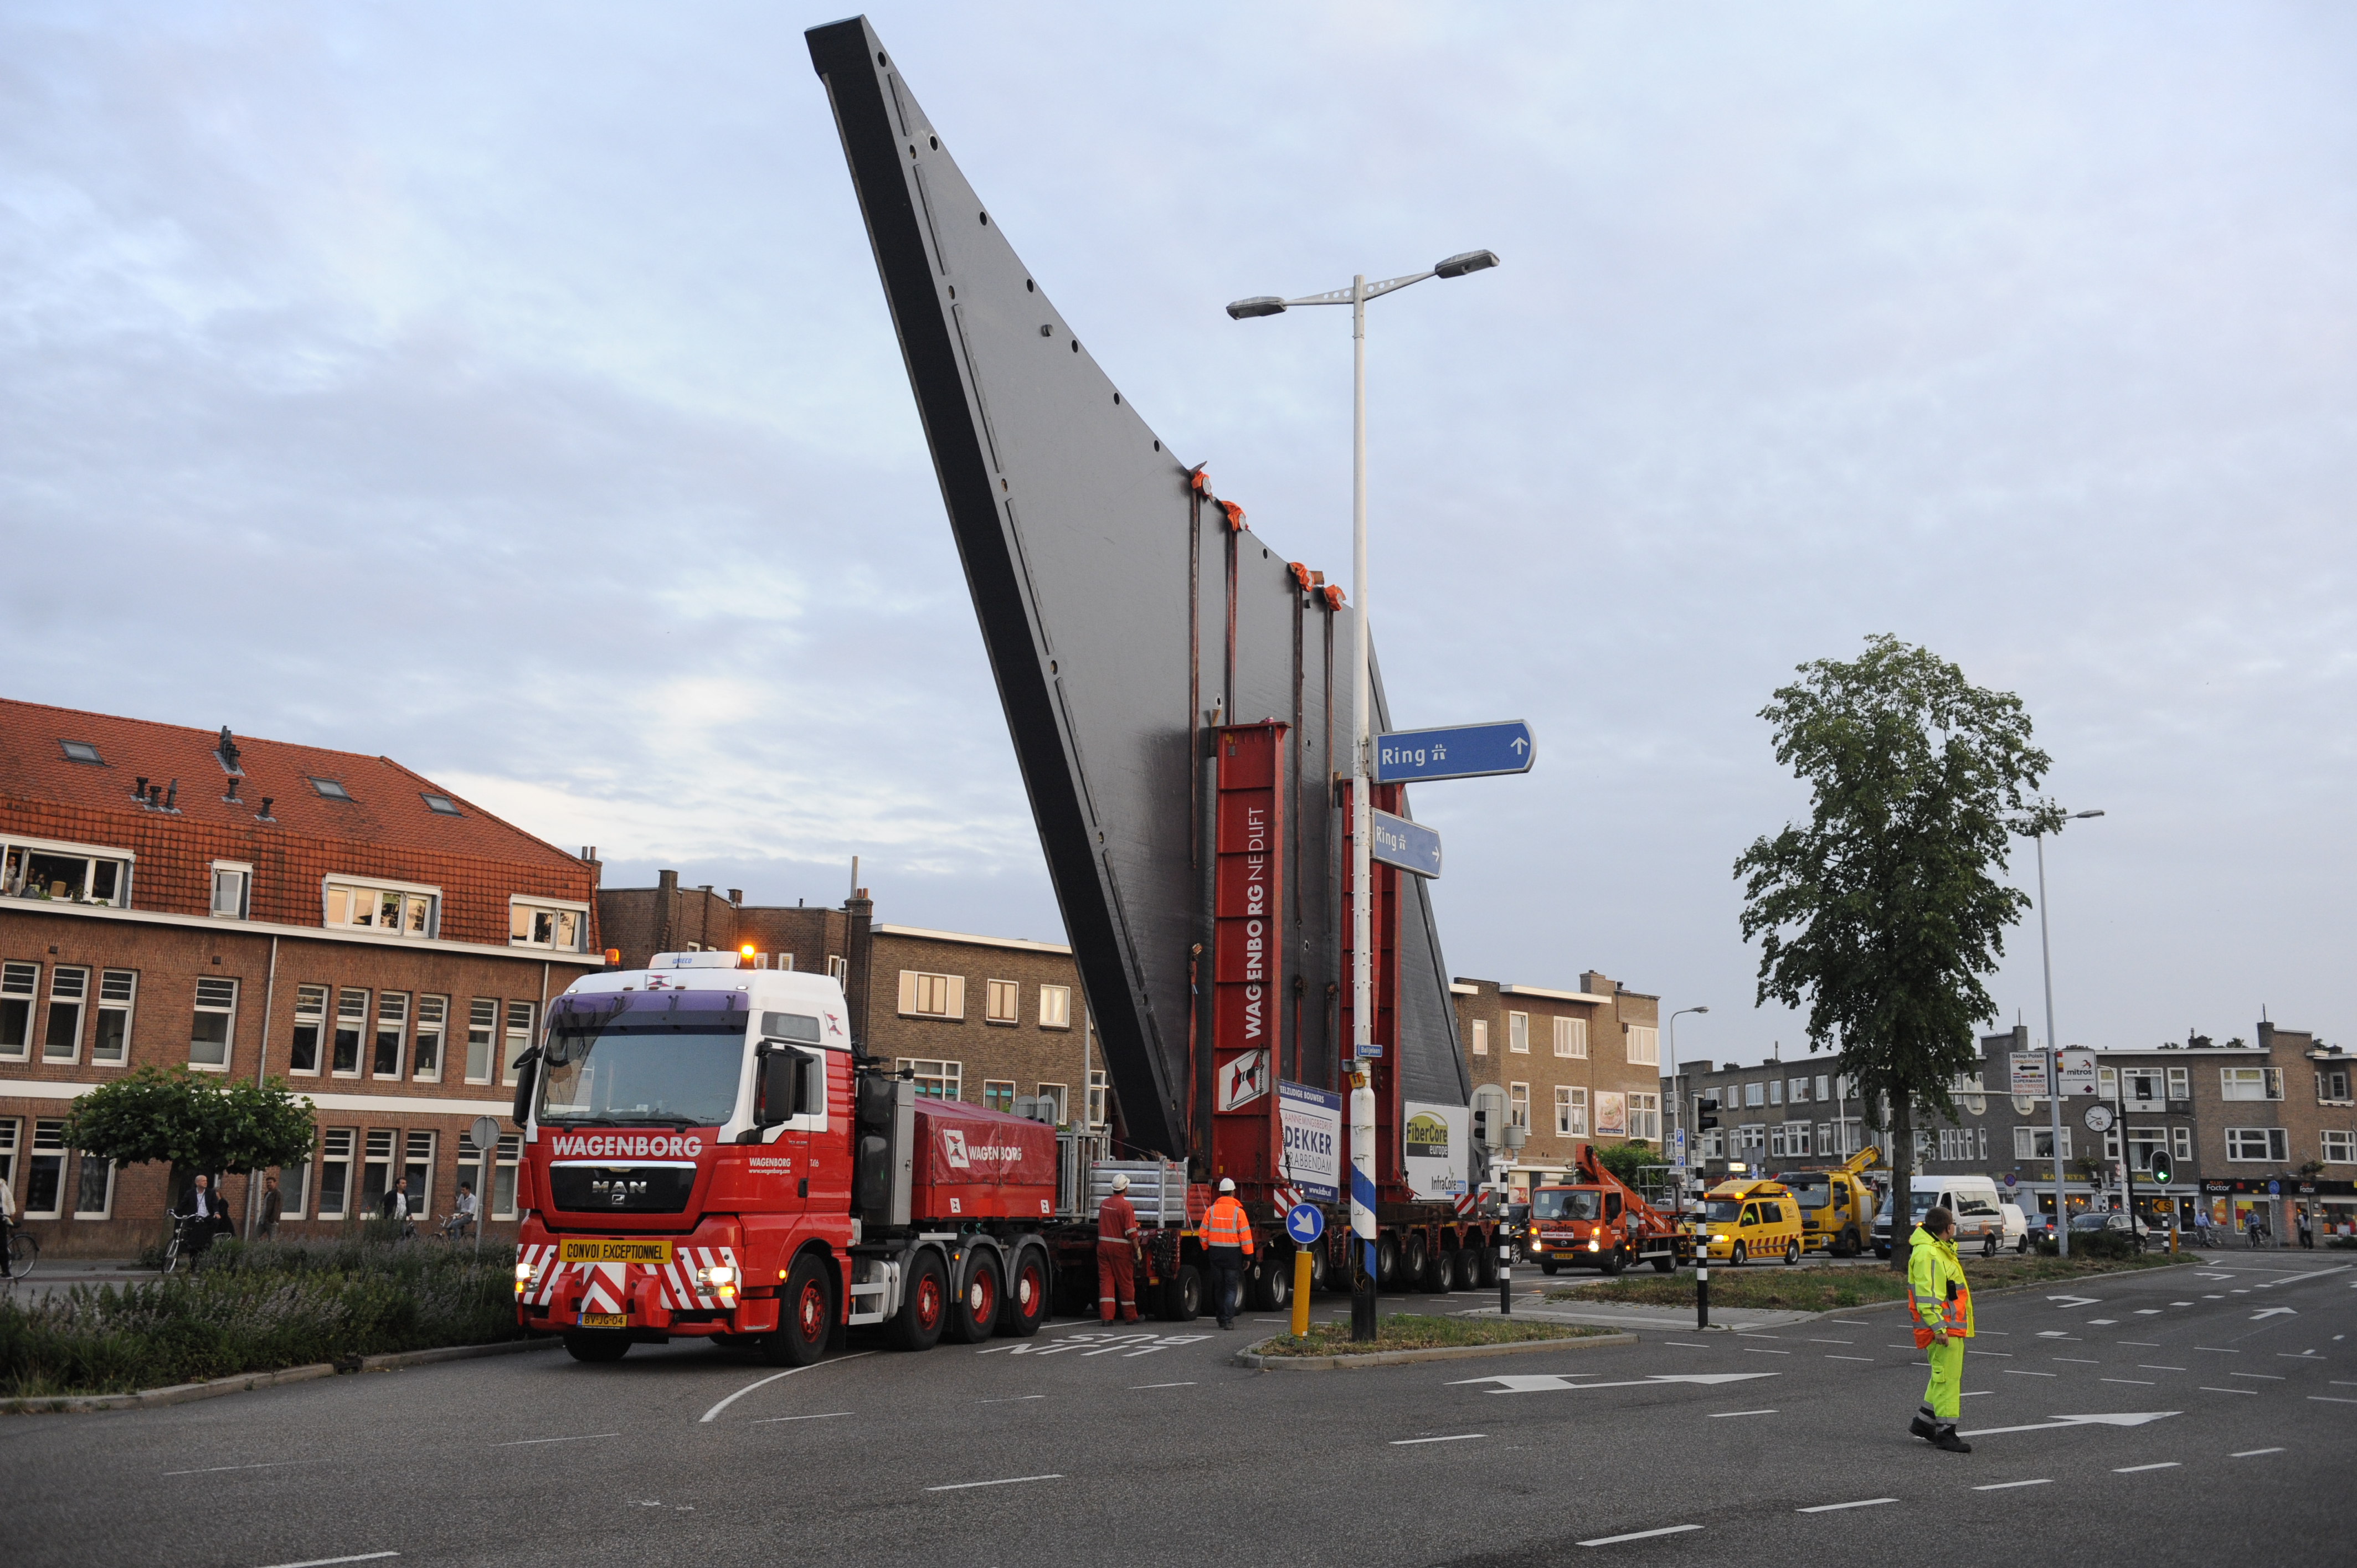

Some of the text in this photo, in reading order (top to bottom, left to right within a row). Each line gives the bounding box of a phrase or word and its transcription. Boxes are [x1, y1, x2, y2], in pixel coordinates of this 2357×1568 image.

[1382, 747, 1425, 766] Ring
[1376, 826, 1397, 852] Ring
[1246, 807, 1264, 1039] WAGENBORG NEDLIFT
[1304, 1091, 1324, 1103] BOUWERS
[1285, 1113, 1332, 1131] AANNEMINGSBEDRIJF
[1407, 1122, 1447, 1142] FiberCore
[552, 1136, 702, 1157] WAGENBORG
[1285, 1125, 1331, 1156] DEKKER
[969, 1146, 1022, 1160] WAGENBORG
[1429, 1145, 1448, 1158] europe
[749, 1158, 791, 1167] WAGENBORG
[592, 1181, 647, 1193] MAN
[1431, 1175, 1457, 1190] InfraCore
[2164, 1202, 2171, 1210] S
[1541, 1224, 1574, 1232] Boels
[567, 1244, 663, 1260] CONVOI EXCEPTIONNEL
[585, 1315, 623, 1325] BV-JG-04
[1051, 1333, 1215, 1344] BUS
